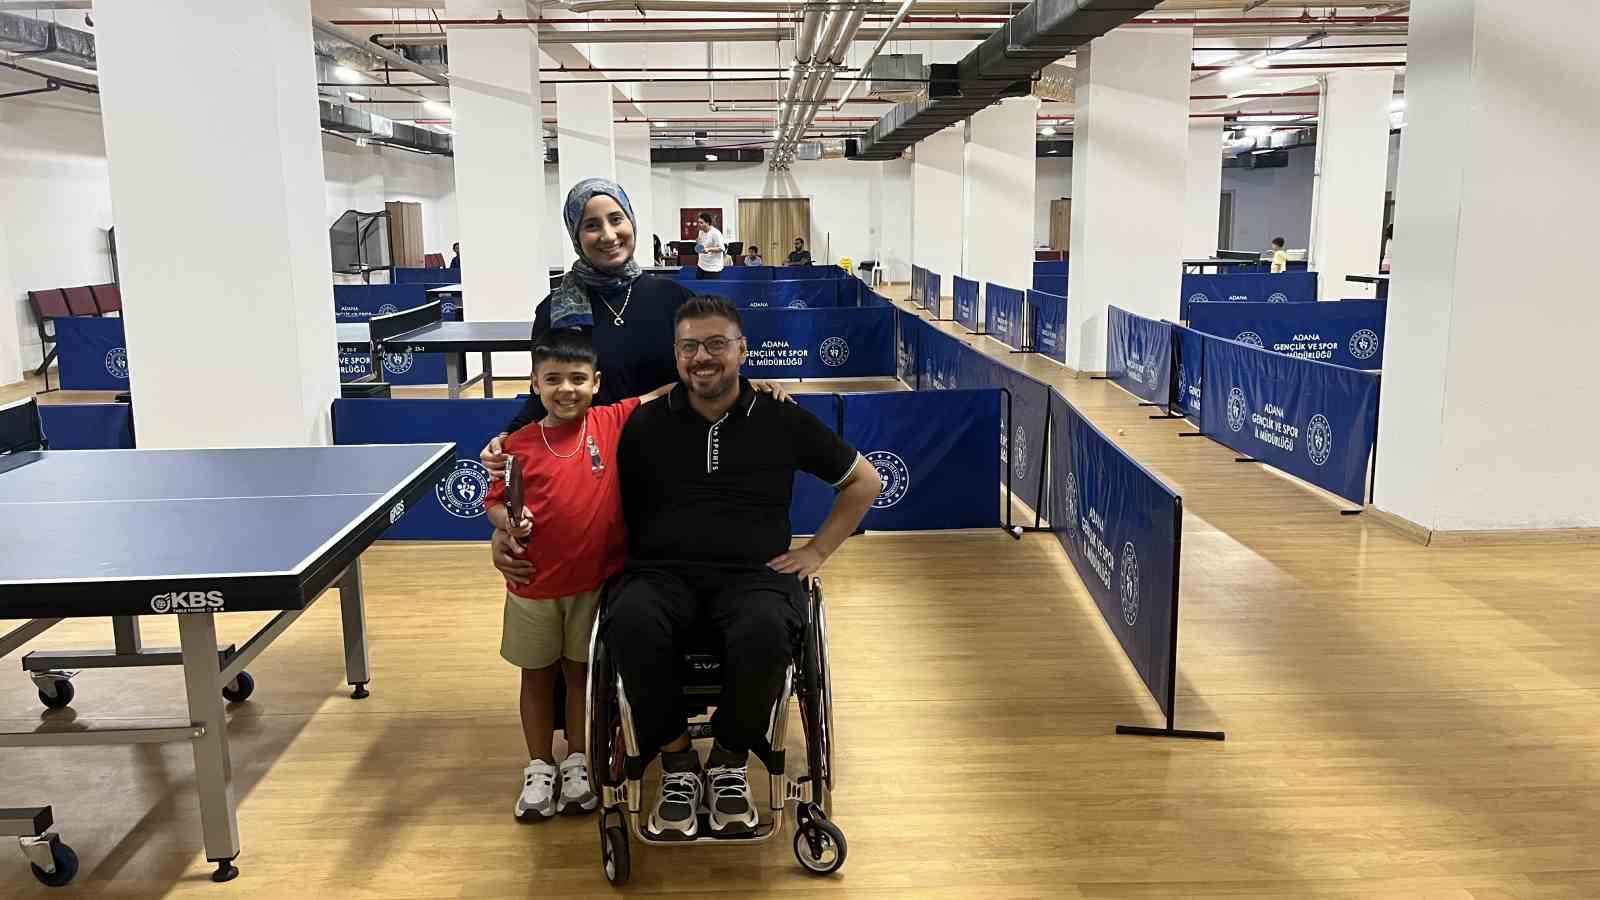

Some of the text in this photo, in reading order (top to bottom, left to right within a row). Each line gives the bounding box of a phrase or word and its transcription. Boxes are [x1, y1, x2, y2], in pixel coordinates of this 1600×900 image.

[1274, 342, 1306, 352] GENÇLİK
[340, 356, 348, 364] VE
[756, 358, 802, 366] MÜDÜRLÜĞÜ
[340, 364, 366, 373] RLÜĞÜ
[1264, 403, 1284, 418] ADANA
[1252, 412, 1298, 438] GENÇLİK VE SPOR
[171, 590, 224, 608] KBS
